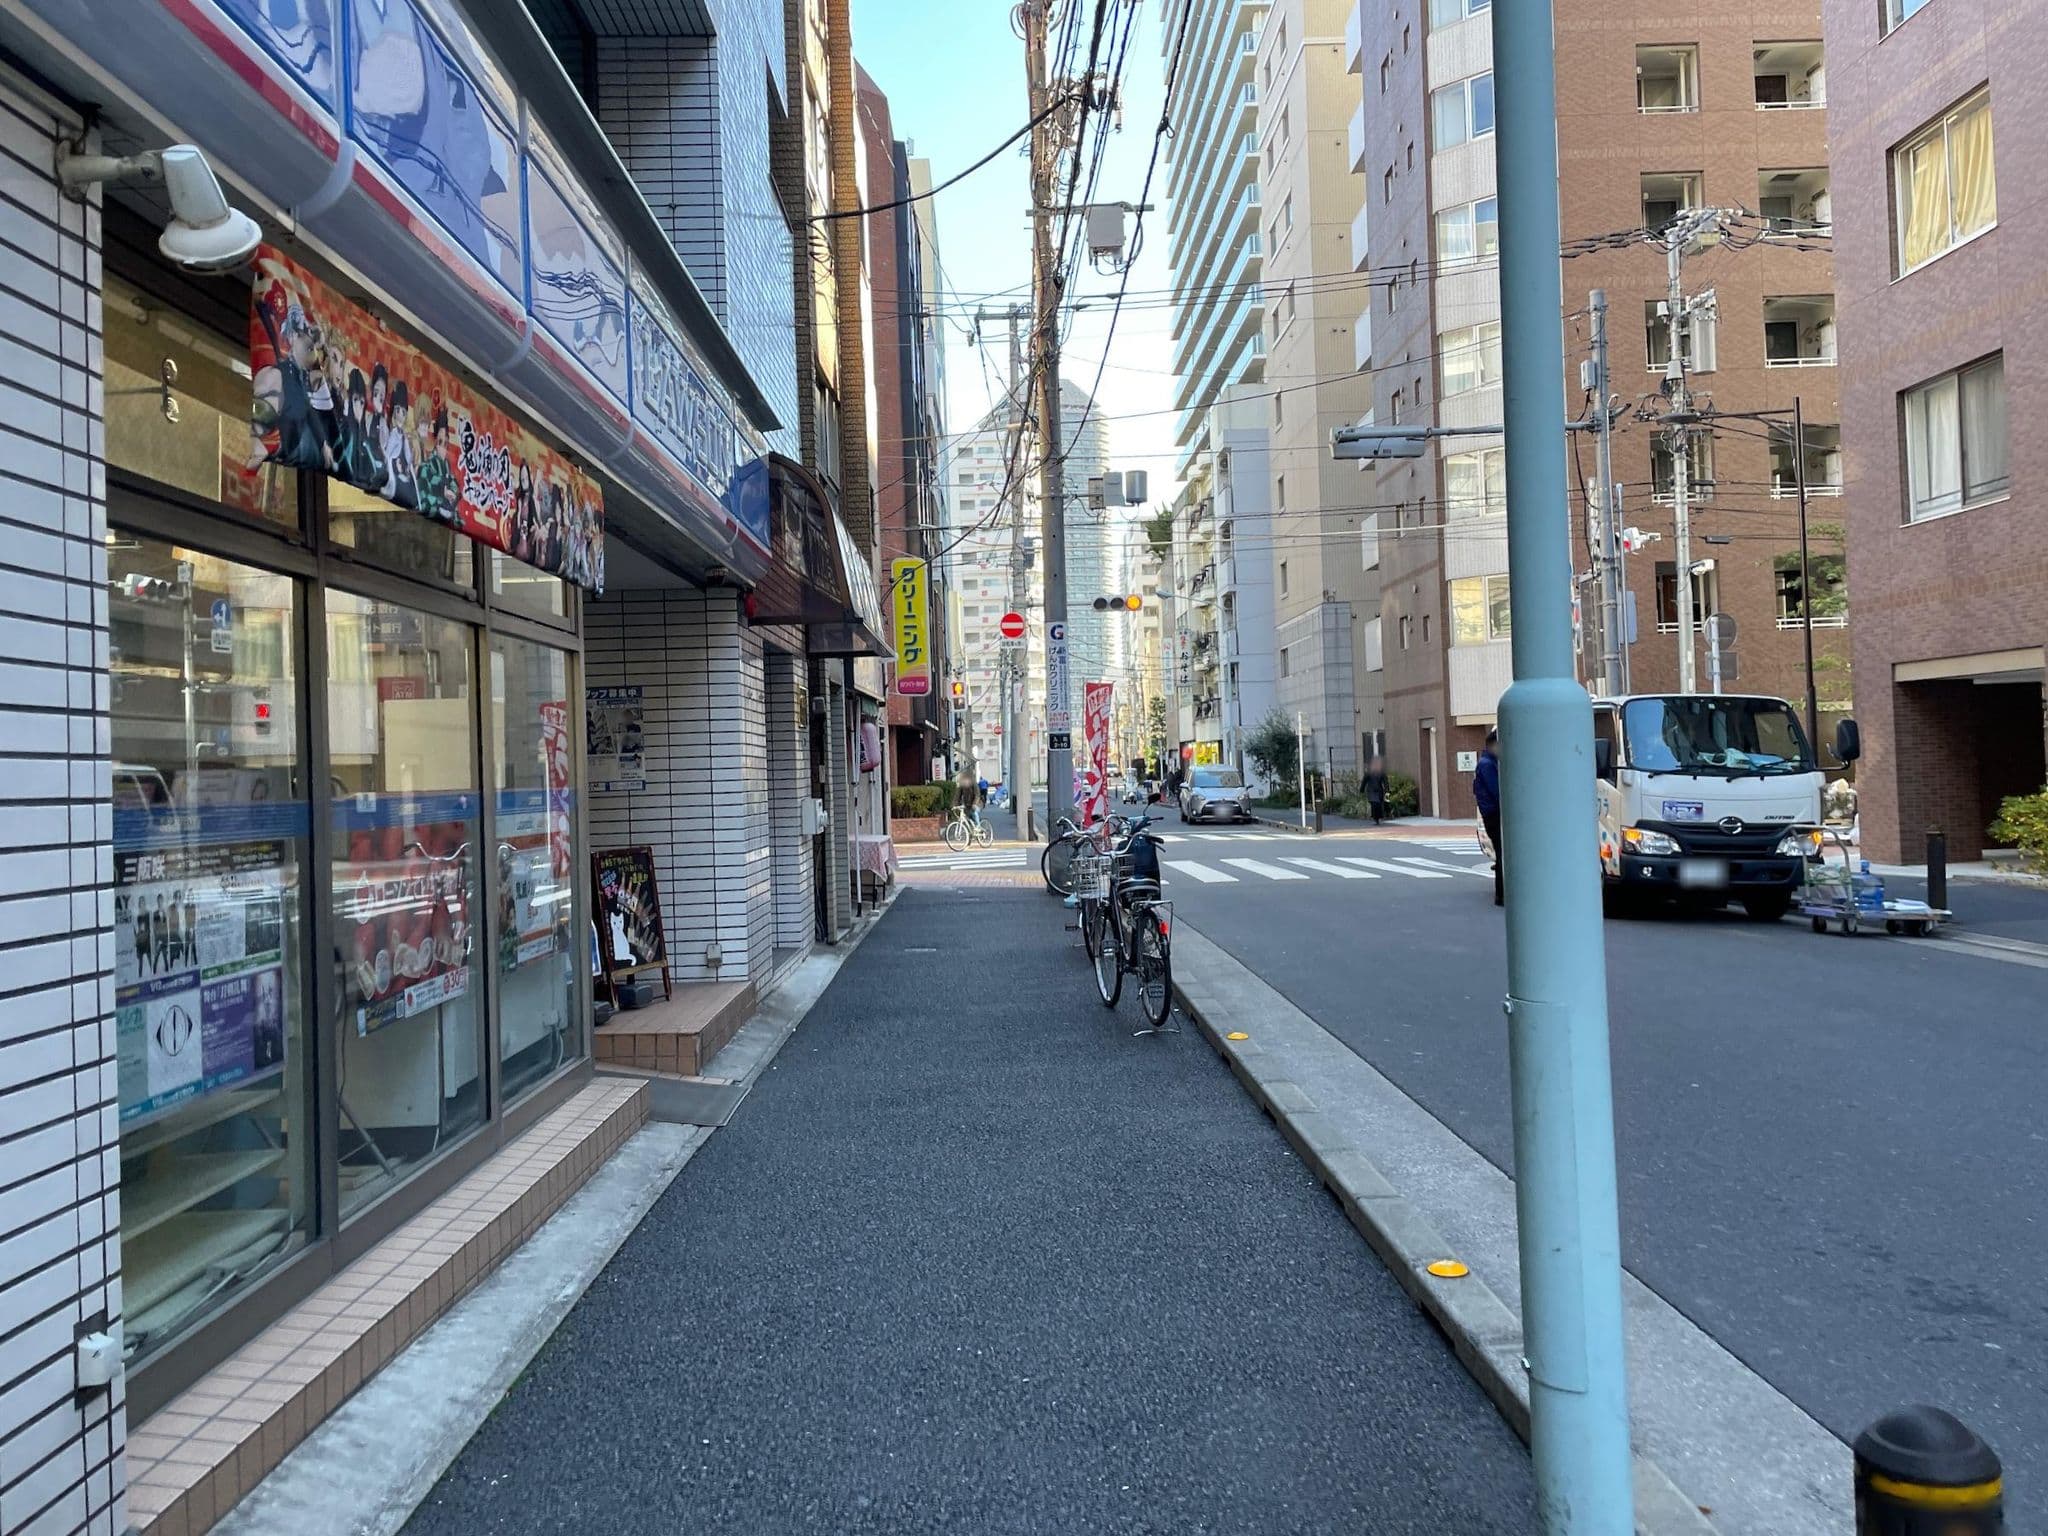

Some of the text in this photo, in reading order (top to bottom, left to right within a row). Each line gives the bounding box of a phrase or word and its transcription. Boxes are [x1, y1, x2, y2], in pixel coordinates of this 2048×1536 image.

[459, 416, 512, 492] 鬼滅の刃
[902, 567, 922, 664] クリーニング
